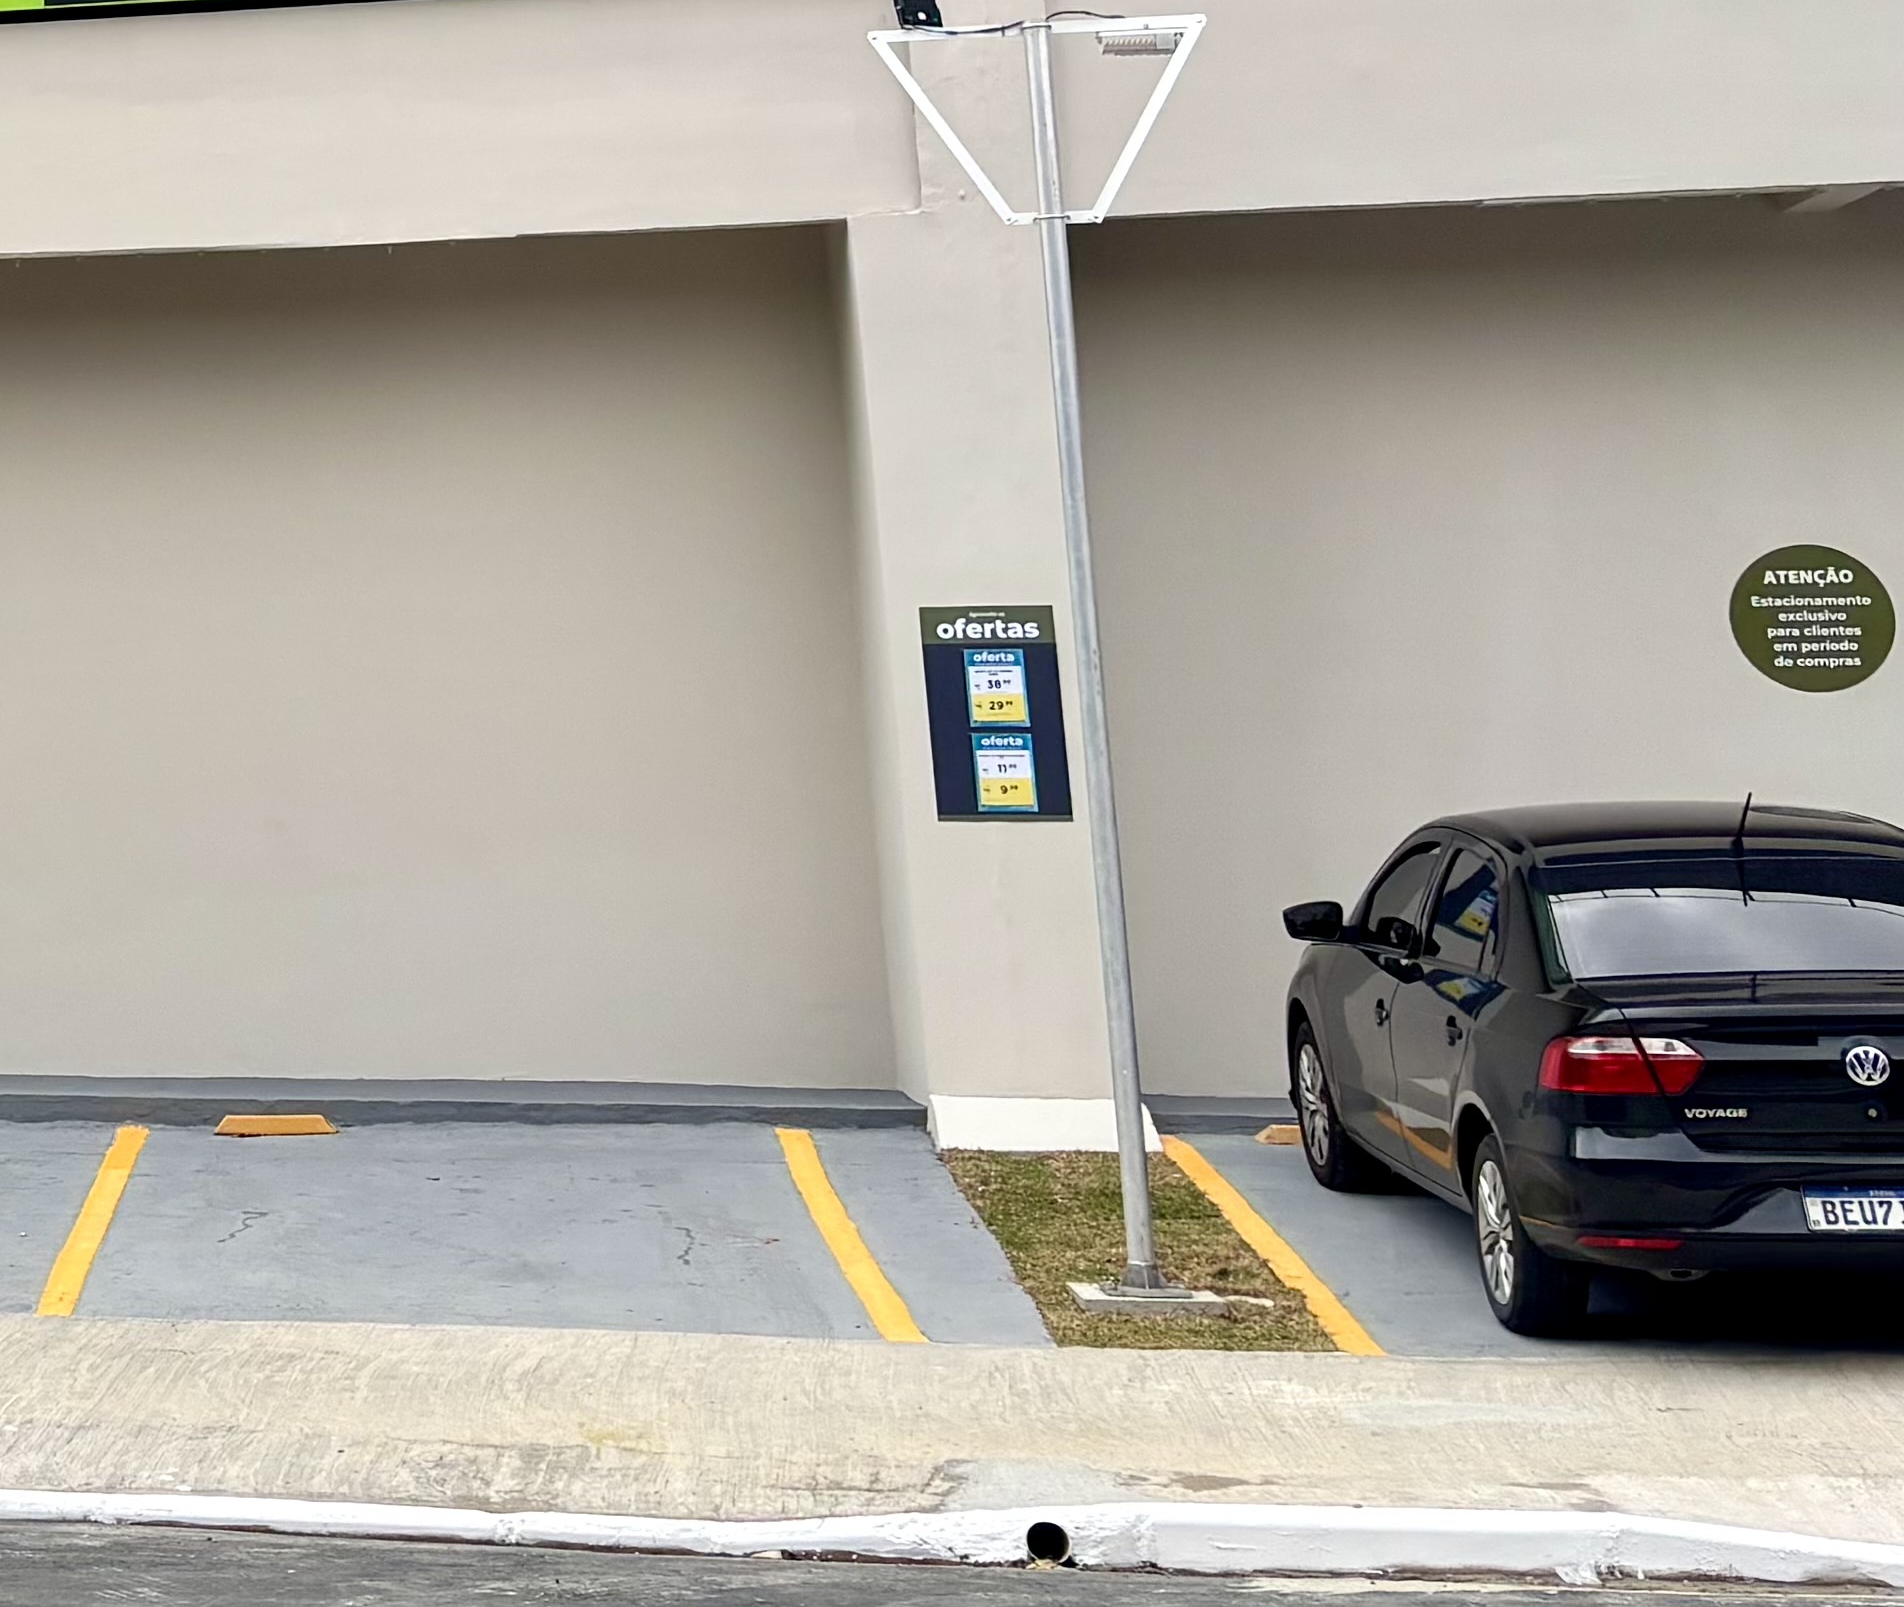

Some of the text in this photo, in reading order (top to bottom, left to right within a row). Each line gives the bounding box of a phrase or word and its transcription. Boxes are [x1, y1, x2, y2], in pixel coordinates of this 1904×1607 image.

[1763, 566, 1854, 588] ATENÇÃO
[1750, 595, 1872, 607] Estacionamento
[1778, 609, 1847, 622] exclusivo
[936, 618, 1040, 639] ofertas
[1767, 624, 1862, 639] para clientes
[1773, 642, 1798, 652] em
[973, 651, 1015, 663] oferta
[1774, 655, 1862, 669] de compras
[981, 735, 1024, 746] oferta
[1684, 1108, 1748, 1119] VOYAGE
